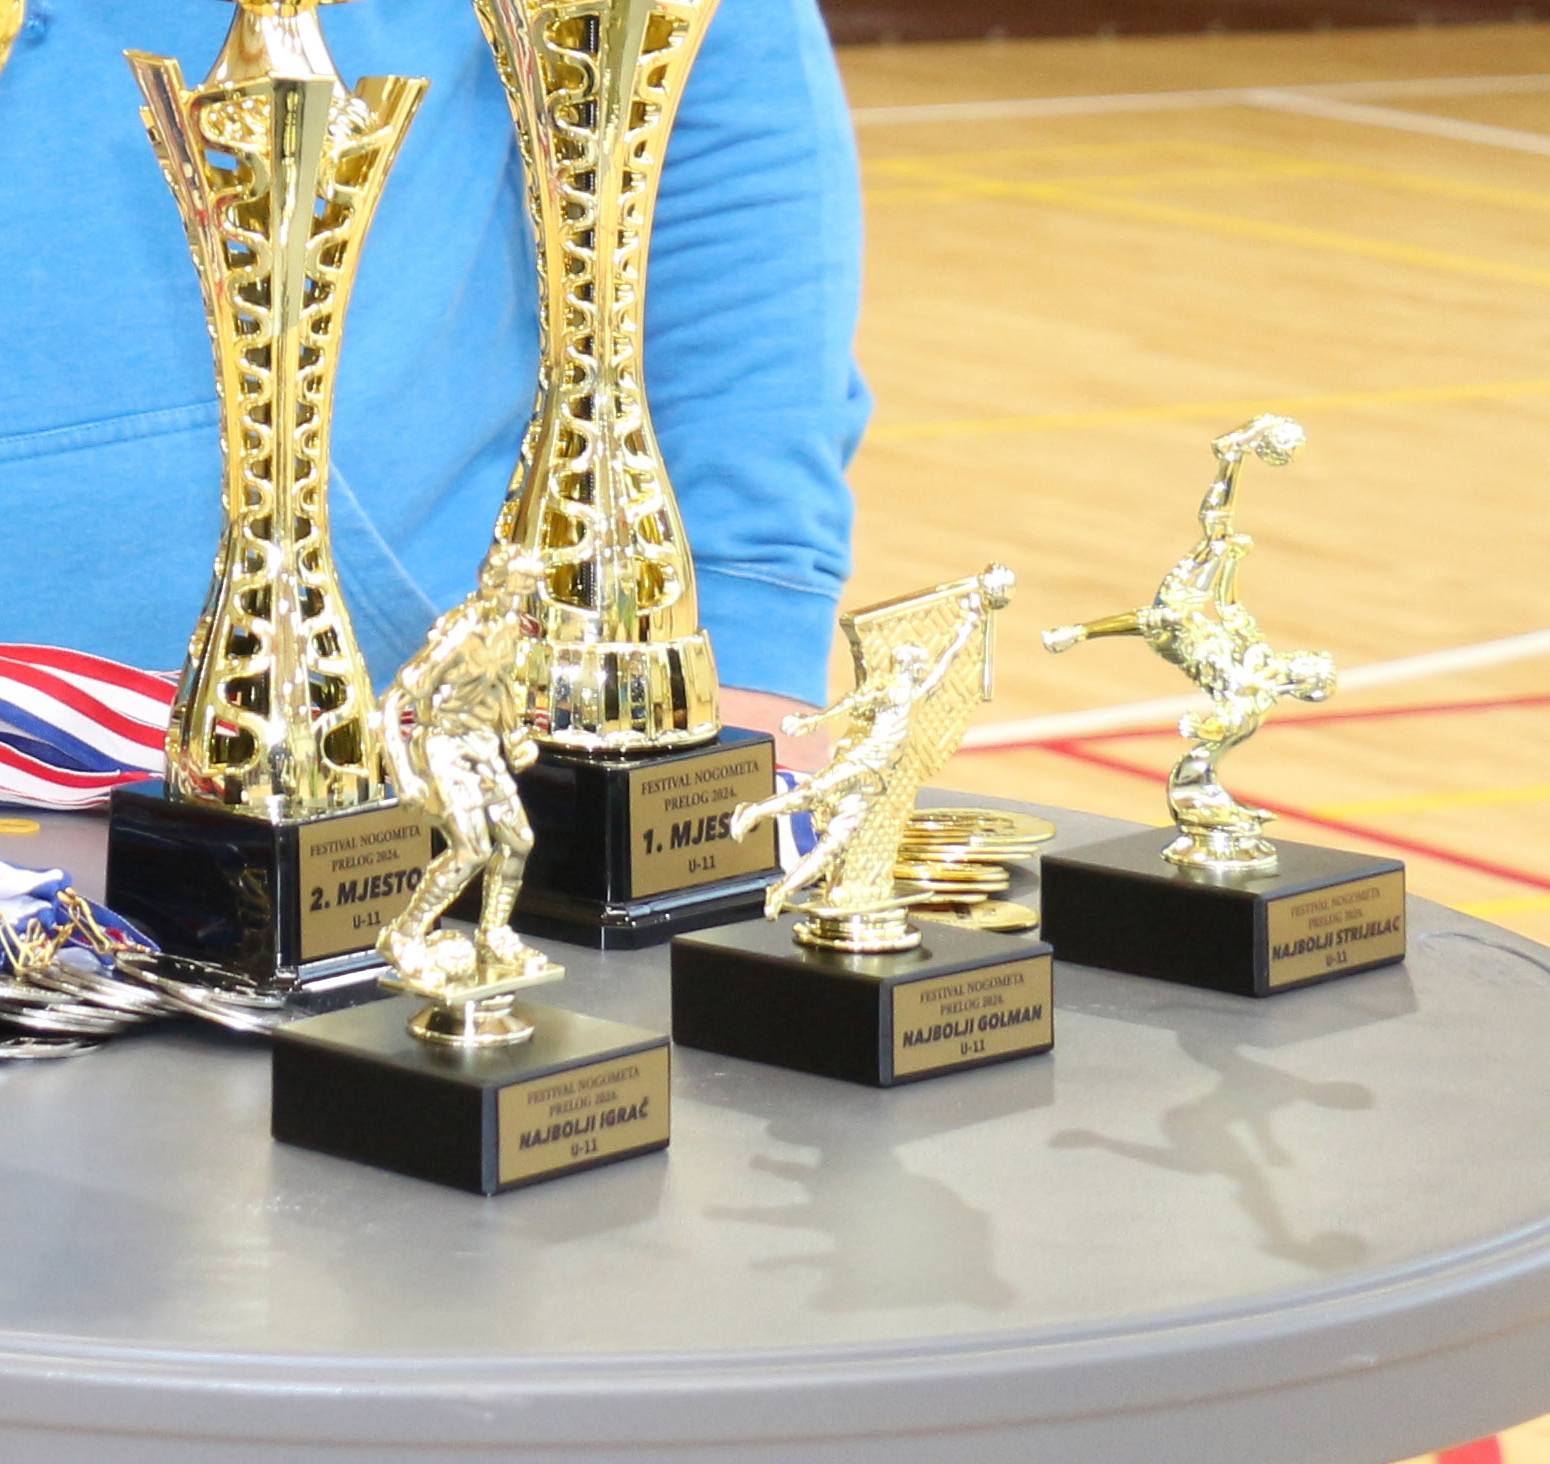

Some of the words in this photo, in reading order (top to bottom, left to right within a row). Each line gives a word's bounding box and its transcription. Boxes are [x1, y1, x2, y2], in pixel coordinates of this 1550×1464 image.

[641, 774, 691, 795] FESTIVAL
[695, 760, 759, 784] NOGOMETA
[664, 792, 708, 812] PRELOG
[712, 787, 738, 803] 2024.
[310, 839, 358, 857] FESTIVAL
[360, 825, 421, 846] NOGOMETA
[643, 828, 663, 855] 1.
[670, 810, 759, 851] MJES
[332, 853, 373, 872] PRELOG
[688, 855, 716, 873] U-11
[309, 887, 330, 912] 2.
[337, 867, 422, 907] MJESTO
[353, 911, 381, 929] U-11
[1272, 932, 1334, 960] NAJBOLJI
[1335, 916, 1401, 946] STRIJELAC
[1326, 950, 1348, 967] U-11
[919, 985, 965, 1004] FESTIVAL
[967, 974, 1025, 994] NOGOMETA
[940, 999, 980, 1016] PRELOG
[902, 1018, 974, 1048] NAJBOLJI
[977, 1004, 1042, 1032] GOLMAN
[961, 1039, 985, 1055] U-11
[527, 1082, 576, 1105] FESTIVAL
[579, 1066, 640, 1091] NOGOMETA
[551, 1097, 592, 1117] PRELOG
[519, 1115, 596, 1151] NAJBOLJI
[600, 1096, 649, 1129] IGRAČ
[571, 1138, 597, 1157] U-11
